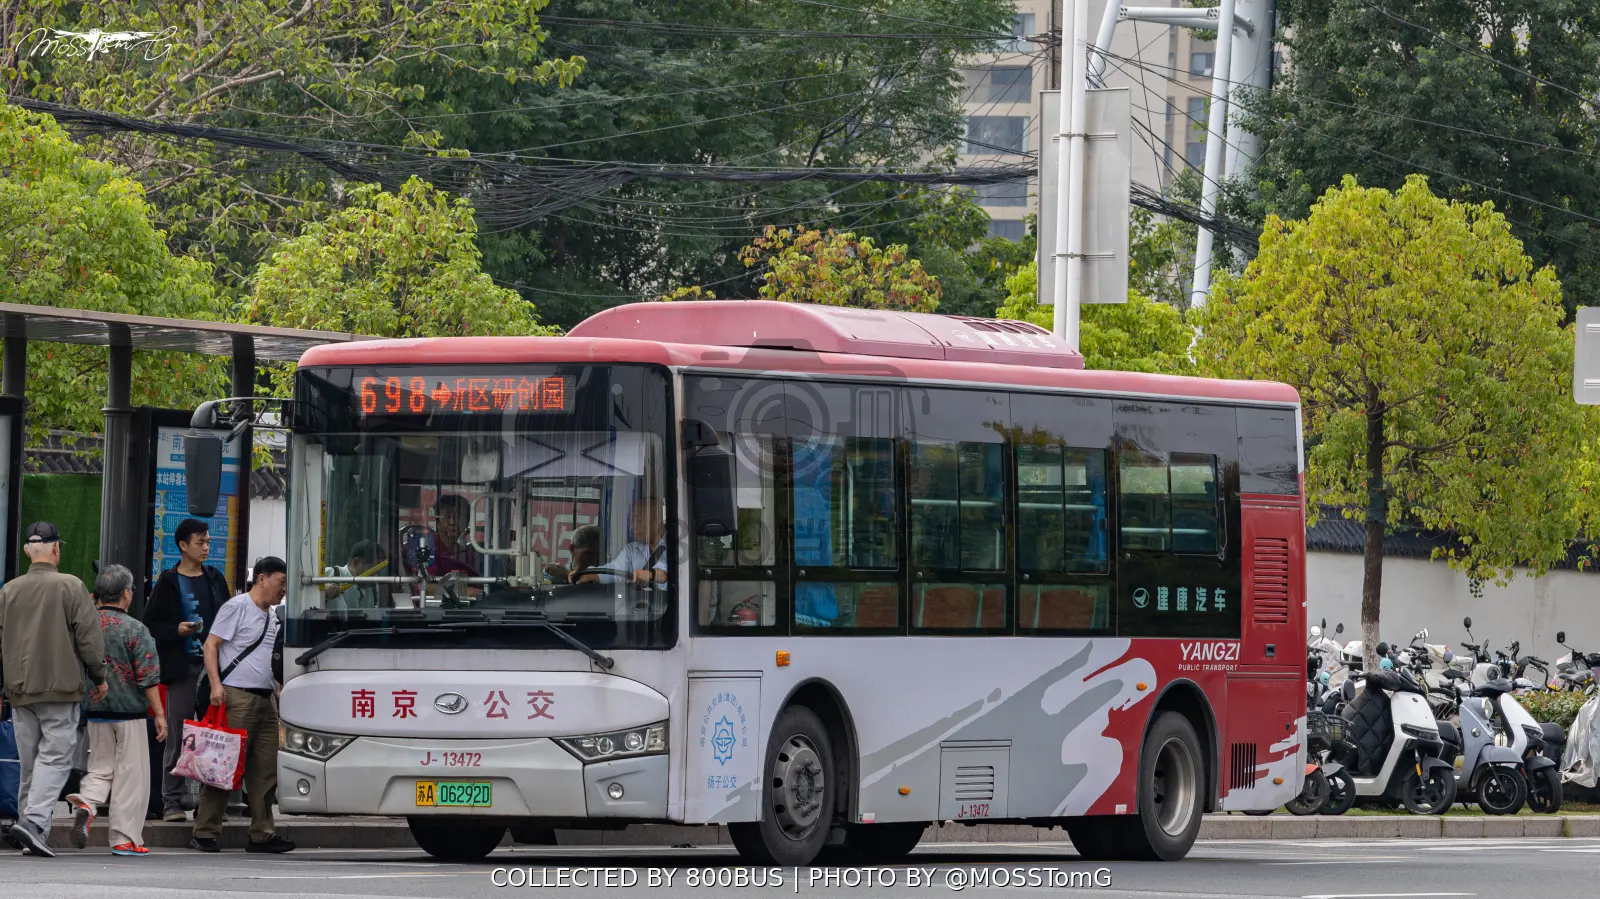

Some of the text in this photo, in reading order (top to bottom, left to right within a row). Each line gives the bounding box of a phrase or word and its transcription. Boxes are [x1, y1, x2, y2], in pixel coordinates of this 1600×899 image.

[361, 376, 426, 413] 698
[1156, 586, 1226, 612] 建康汽车
[1180, 642, 1241, 661] YANGZI
[1178, 663, 1200, 671] PUBLIC
[707, 775, 738, 790] 扬子公交
